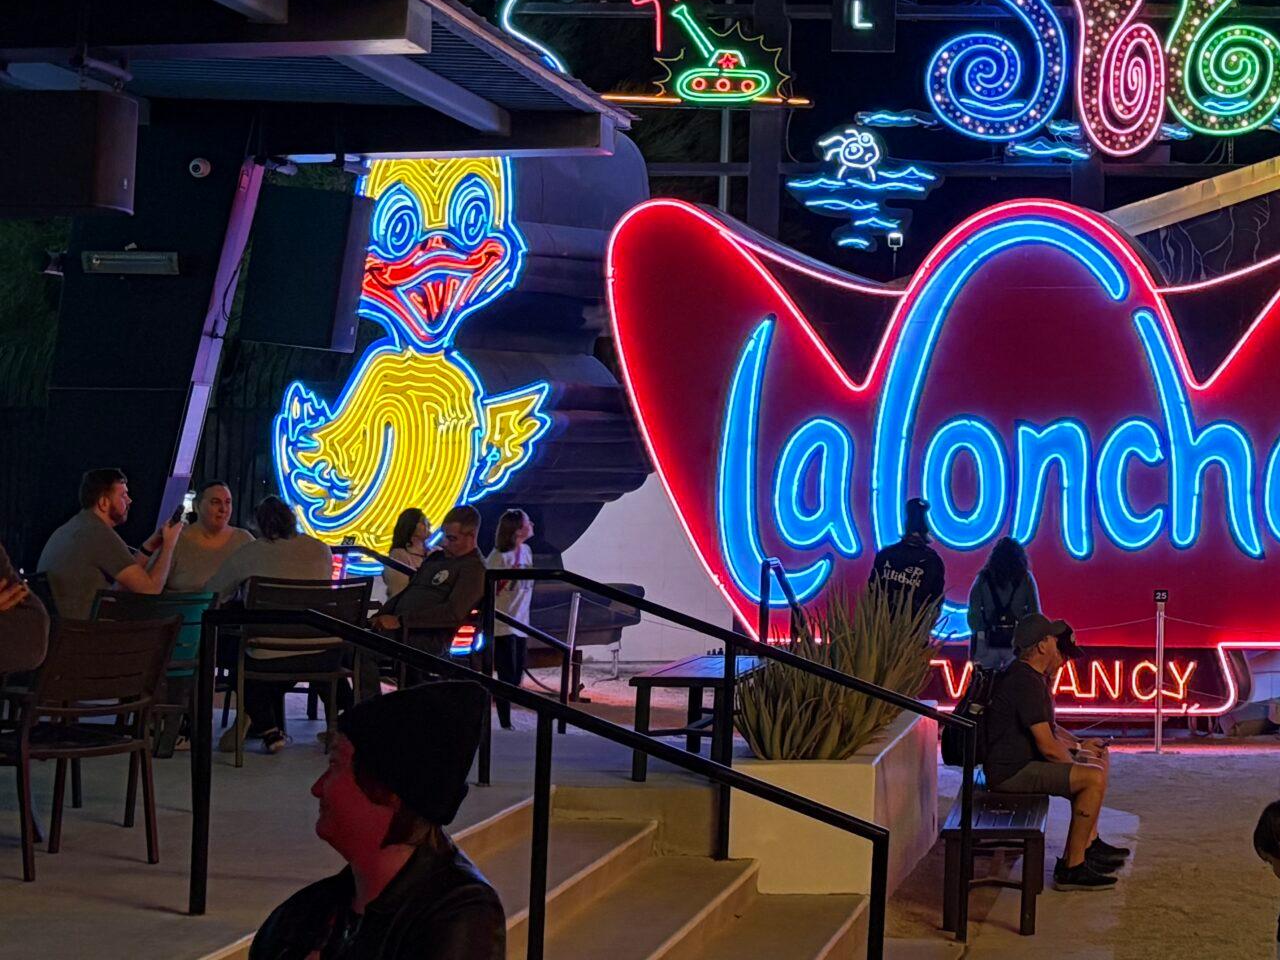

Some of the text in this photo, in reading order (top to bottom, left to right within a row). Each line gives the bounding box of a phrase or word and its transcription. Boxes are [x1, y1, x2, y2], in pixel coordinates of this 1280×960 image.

[719, 314, 862, 608] La
[1155, 591, 1167, 600] 25
[932, 658, 1197, 702] VANCY
